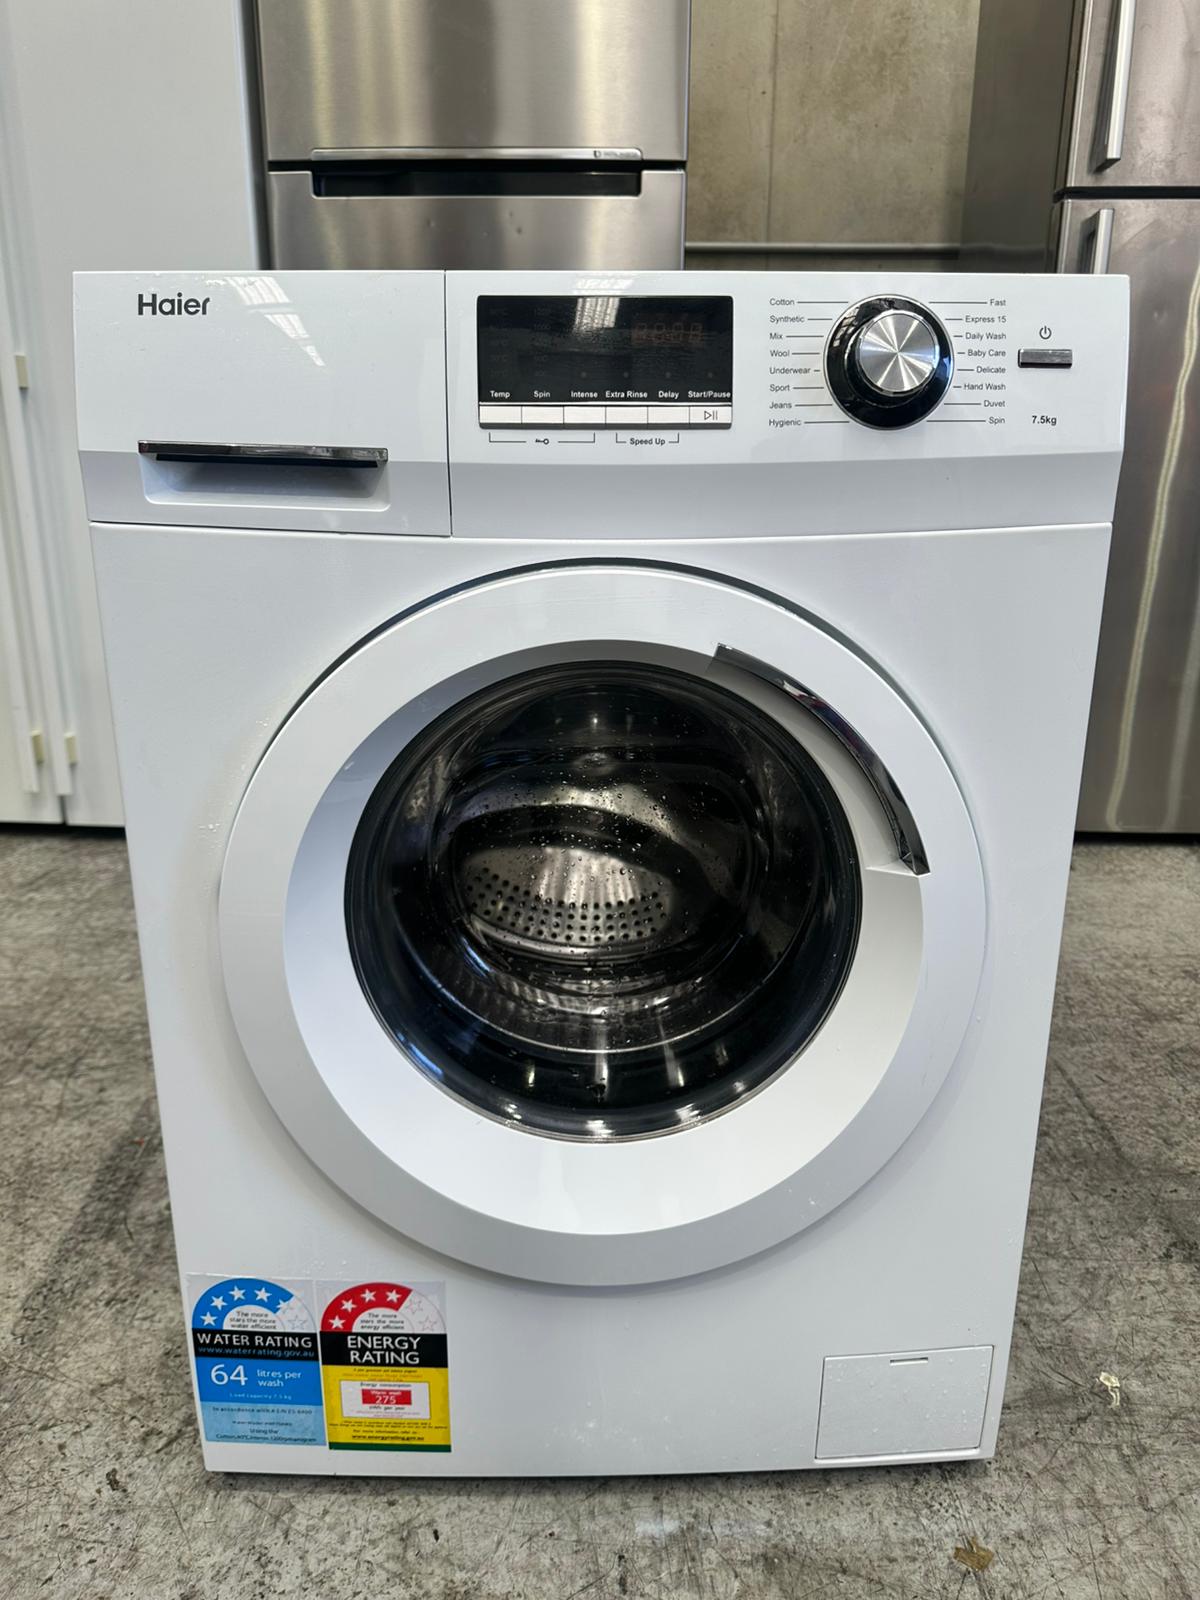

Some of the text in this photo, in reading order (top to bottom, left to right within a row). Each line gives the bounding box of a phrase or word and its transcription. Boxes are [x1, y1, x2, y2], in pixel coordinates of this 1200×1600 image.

[138, 292, 210, 315] Haier
[770, 298, 794, 306] Cotton
[770, 315, 804, 324] Synthetic
[966, 316, 995, 324] Express
[966, 332, 984, 340] Daily
[968, 349, 986, 357] Baby
[770, 384, 790, 392] Sport
[490, 390, 510, 398] Temp
[534, 390, 550, 398] Spin
[571, 390, 598, 398] Intense
[606, 390, 648, 398] Extra Rinse
[658, 390, 679, 399] Delay
[769, 419, 801, 427] Hygienic
[989, 417, 1005, 425] Spin
[1032, 416, 1057, 426] 7.5kg
[630, 438, 665, 446] Speed Up
[197, 1333, 312, 1348] WATER RATING
[347, 1336, 420, 1350] ENERGY
[198, 1347, 315, 1357] www.waterrating.gov.au
[350, 1350, 419, 1364] RATING
[211, 1364, 248, 1386] 64
[257, 1369, 301, 1380] litres per
[258, 1379, 284, 1387] wash
[375, 1396, 396, 1404] 275
